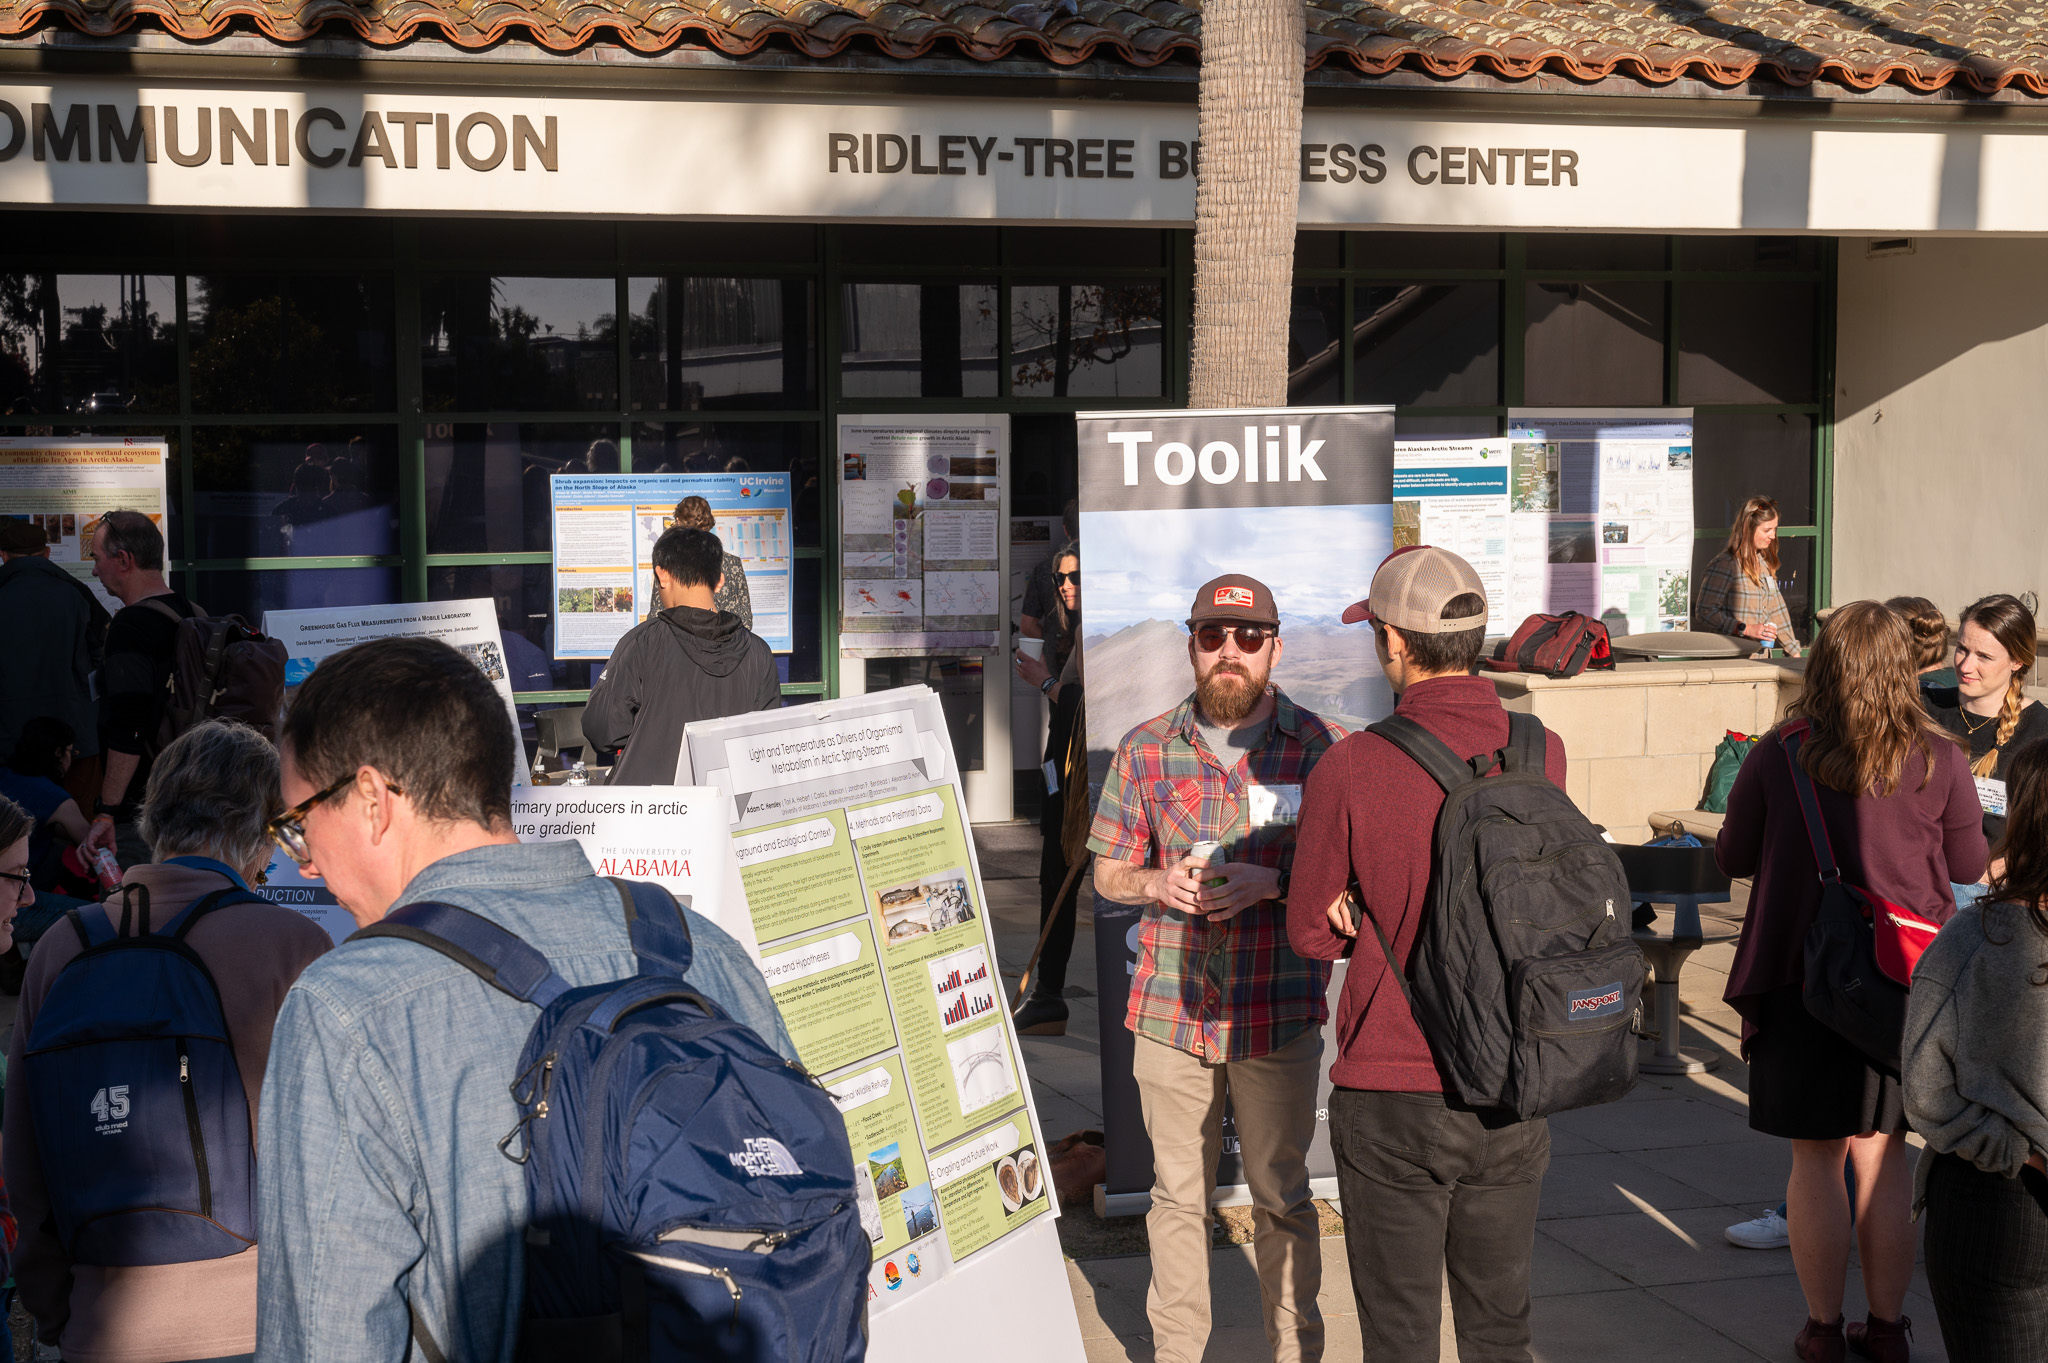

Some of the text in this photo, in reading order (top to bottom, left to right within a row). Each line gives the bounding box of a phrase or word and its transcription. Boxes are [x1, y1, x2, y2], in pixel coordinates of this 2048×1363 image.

[0, 100, 559, 172] OMMUNICATION
[828, 132, 1579, 188] RIDLEY-TREE BESS CENTER
[5, 450, 42, 458] community
[45, 450, 71, 458] changes
[1107, 424, 1327, 486] Toolik
[756, 477, 784, 485] Irvine
[748, 724, 903, 762] Light and Temperature as Drivers of Organismal
[772, 743, 890, 774] Metabolism in Arctic Spring-Streams
[510, 798, 688, 819] rimary producers in arctic
[746, 805, 760, 814] Adam
[850, 805, 932, 831] 4. Methods and Preliminary Data
[512, 820, 595, 838] ure gradient
[764, 840, 777, 852] and
[777, 832, 808, 849] Ecological
[809, 828, 831, 841] Context
[600, 847, 619, 855] THE
[623, 848, 676, 856] UNIVERSITY
[596, 858, 692, 877] ALABAMA
[256, 889, 315, 902] DUCTION
[765, 951, 831, 978] ctive and Hypotheses
[1571, 991, 1620, 1012] JANSPORT
[855, 1085, 871, 1096] Wildlife
[871, 1079, 889, 1090] Refuge
[90, 1085, 130, 1122] 45
[95, 1121, 128, 1132] club med
[743, 1138, 768, 1151] THE
[729, 1152, 772, 1166] NORTH
[930, 1141, 998, 1181] 5. Ongoing and Future Work
[745, 1164, 779, 1177] FACE
